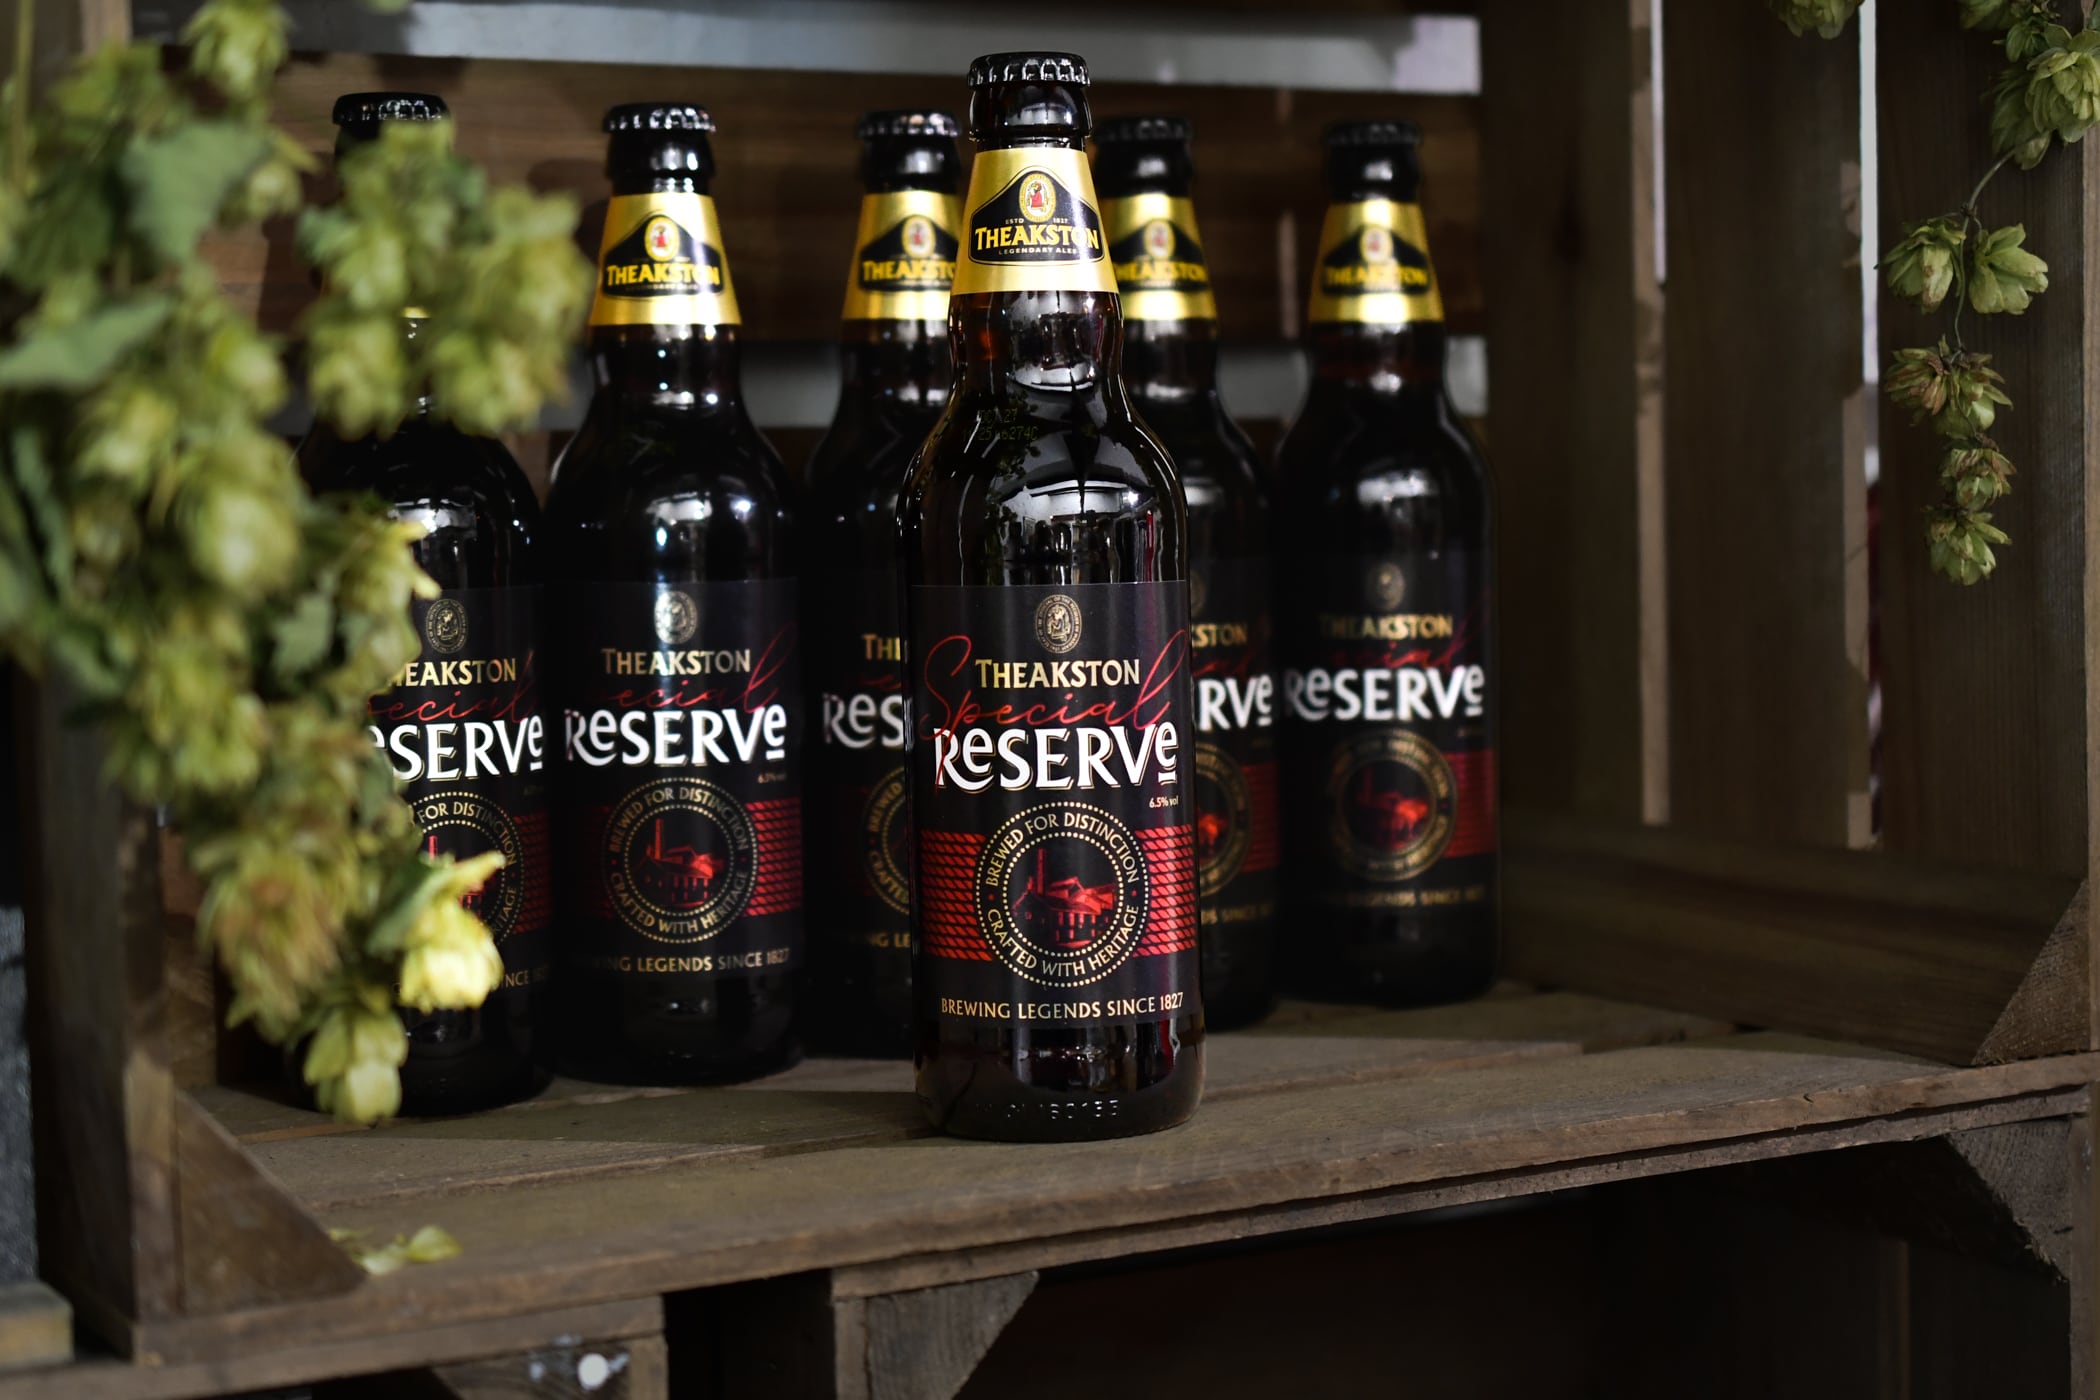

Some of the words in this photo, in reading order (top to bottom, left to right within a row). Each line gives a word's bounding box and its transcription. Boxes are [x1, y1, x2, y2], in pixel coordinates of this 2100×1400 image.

[975, 224, 1099, 251] THEAKSTON
[600, 648, 752, 676] THEAKSTON
[975, 658, 1141, 689] THEAKSTON
[919, 629, 1188, 800] Special
[608, 801, 644, 853] BREWED
[643, 787, 675, 807] FOR
[678, 787, 749, 851] DISTINCTION
[985, 829, 1024, 888] BREWED
[1023, 813, 1060, 836] FOR
[1063, 812, 1140, 885] DISTINCTION
[610, 872, 656, 928] CRAFTED
[658, 919, 700, 935] WITH
[699, 871, 748, 929] HERITAGE
[636, 956, 714, 974] LEGENDS
[716, 951, 763, 971] SINCE
[987, 908, 1038, 970] CRAFTED
[1042, 960, 1087, 977] WITH
[1087, 905, 1140, 971] HERITAGE
[940, 997, 1011, 1019] BREWING
[1017, 1001, 1102, 1020] LEGENDS
[1106, 996, 1157, 1017] SINCE
[1159, 991, 1184, 1012] 1827
